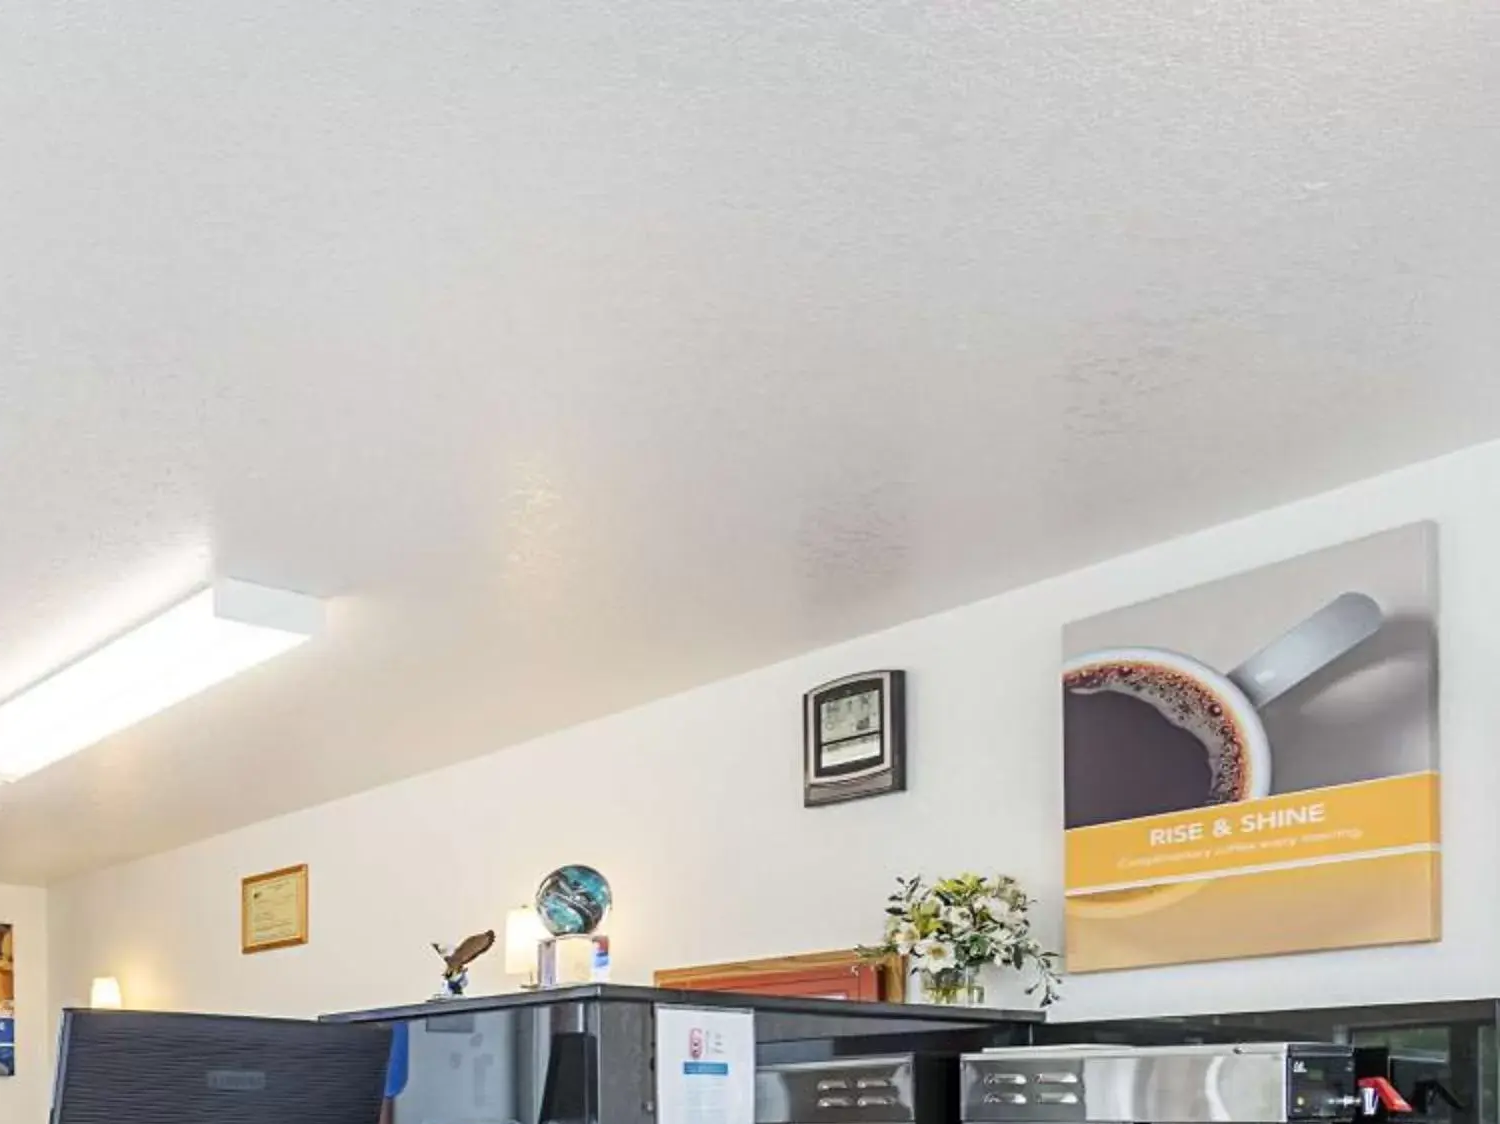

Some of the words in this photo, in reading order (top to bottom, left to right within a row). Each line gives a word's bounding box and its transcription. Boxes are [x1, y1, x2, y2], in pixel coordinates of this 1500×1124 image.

[1150, 822, 1204, 847] RISE
[1212, 819, 1232, 838] &
[1240, 803, 1326, 833] SHINE
